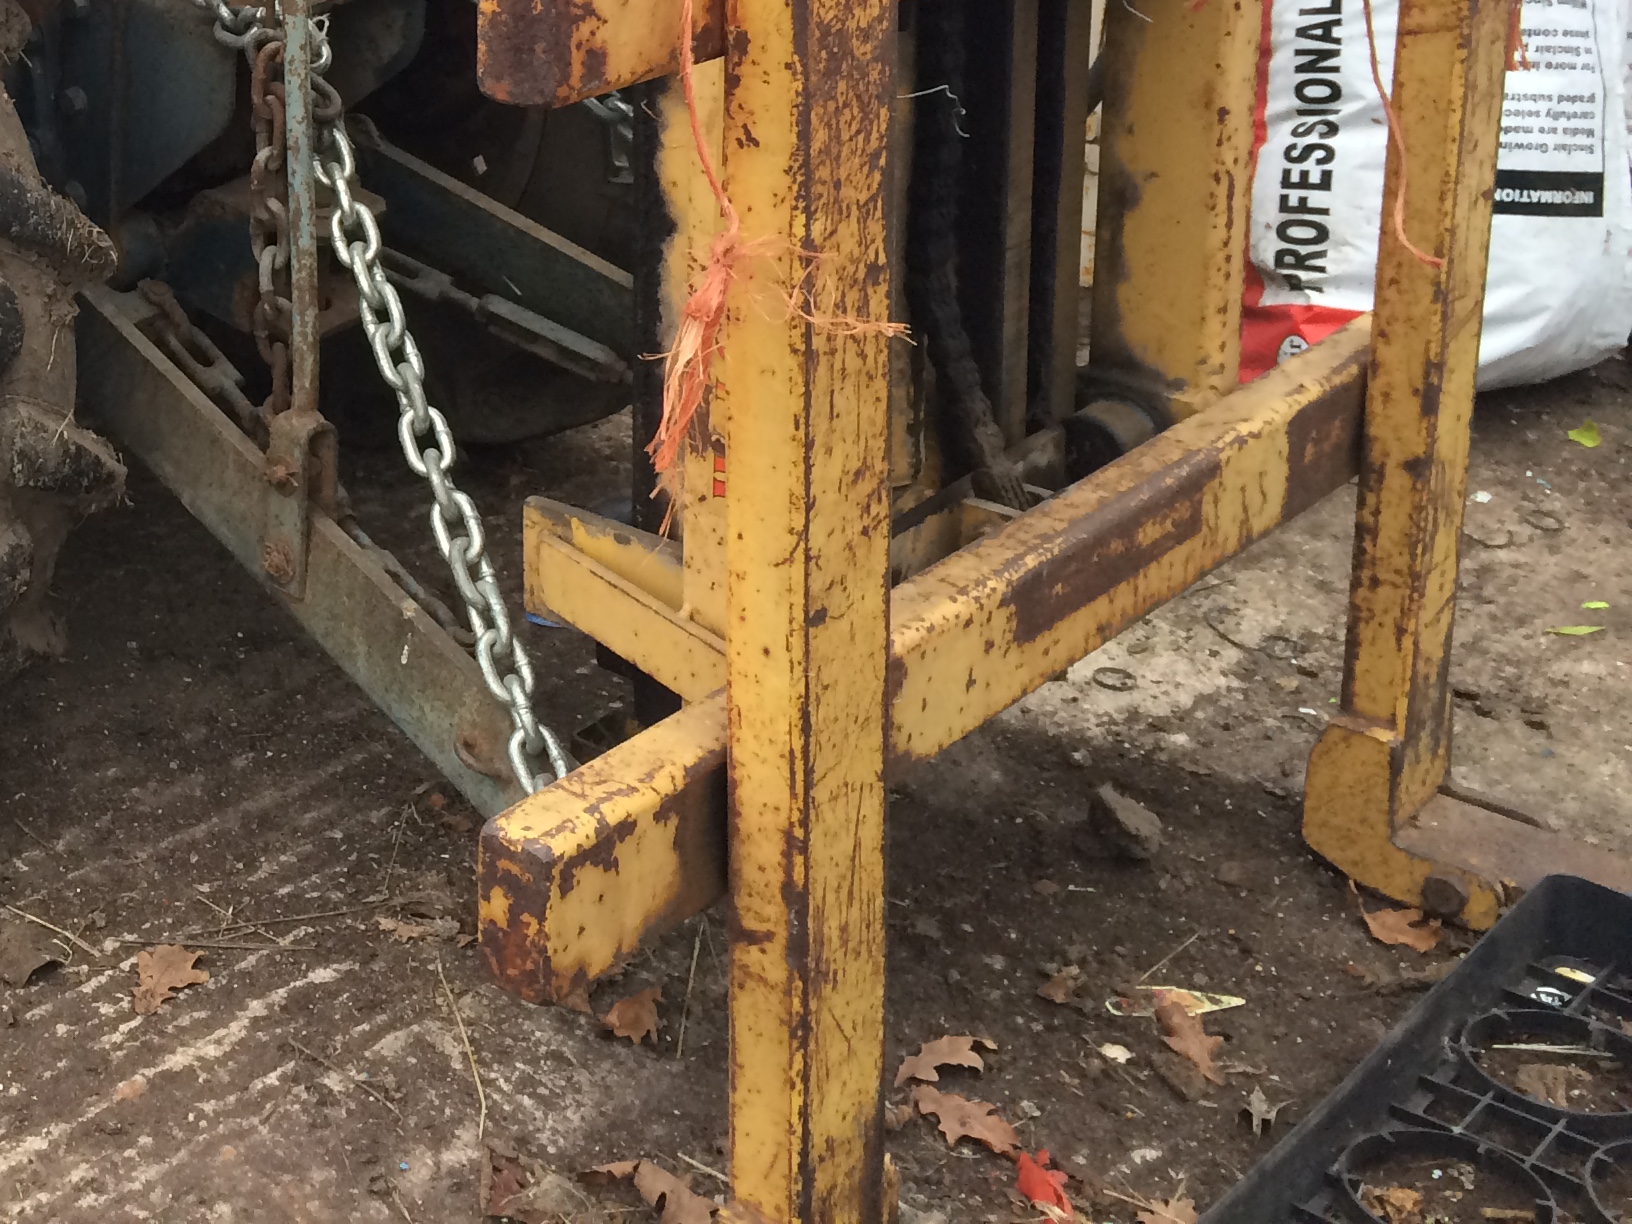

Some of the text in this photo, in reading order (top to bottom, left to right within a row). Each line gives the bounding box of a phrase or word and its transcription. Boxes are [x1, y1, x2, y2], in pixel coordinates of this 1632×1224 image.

[1534, 46, 1581, 57] Sinclair
[1545, 62, 1577, 71] more
[1557, 93, 1596, 105] graded
[1545, 109, 1596, 122] carefully
[1538, 127, 1559, 135] are
[1563, 127, 1595, 138] Media
[1553, 143, 1594, 155] Sinclair
